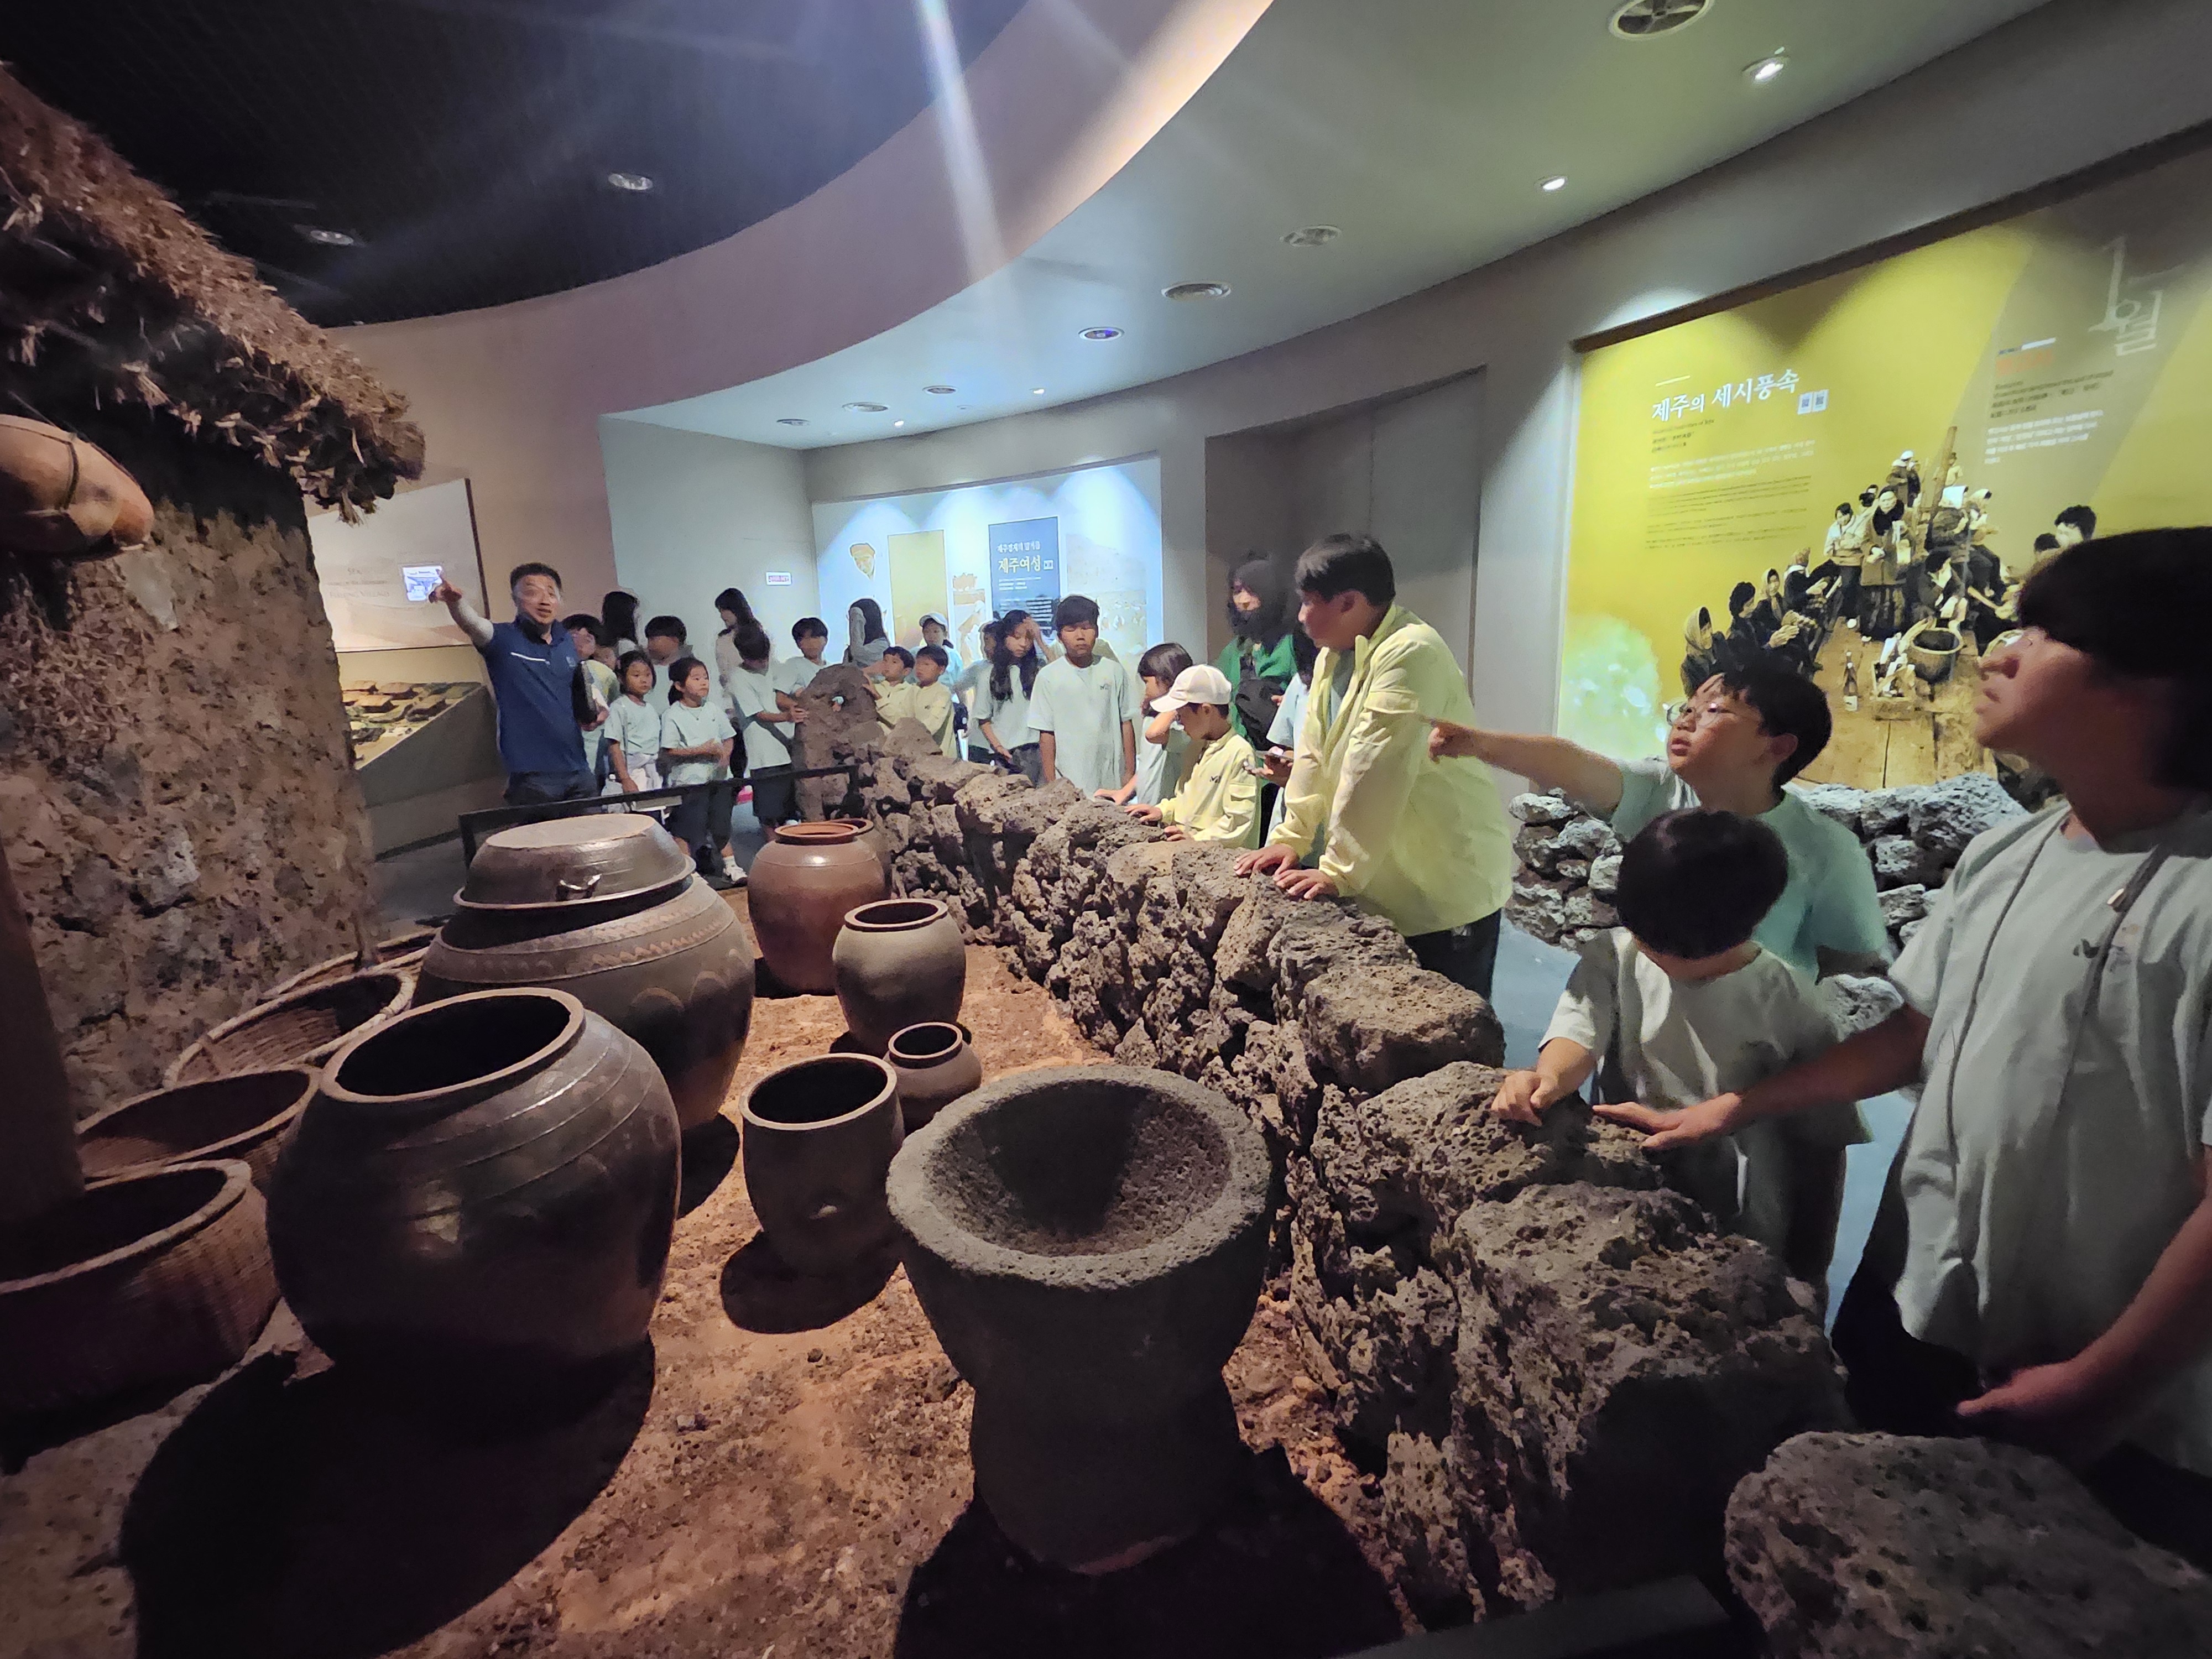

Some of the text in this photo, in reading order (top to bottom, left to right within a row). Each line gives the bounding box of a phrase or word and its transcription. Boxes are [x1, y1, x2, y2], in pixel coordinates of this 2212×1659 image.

[1652, 369, 1799, 421] 제주의 세시풍속
[998, 555, 1041, 574] 제주여성
